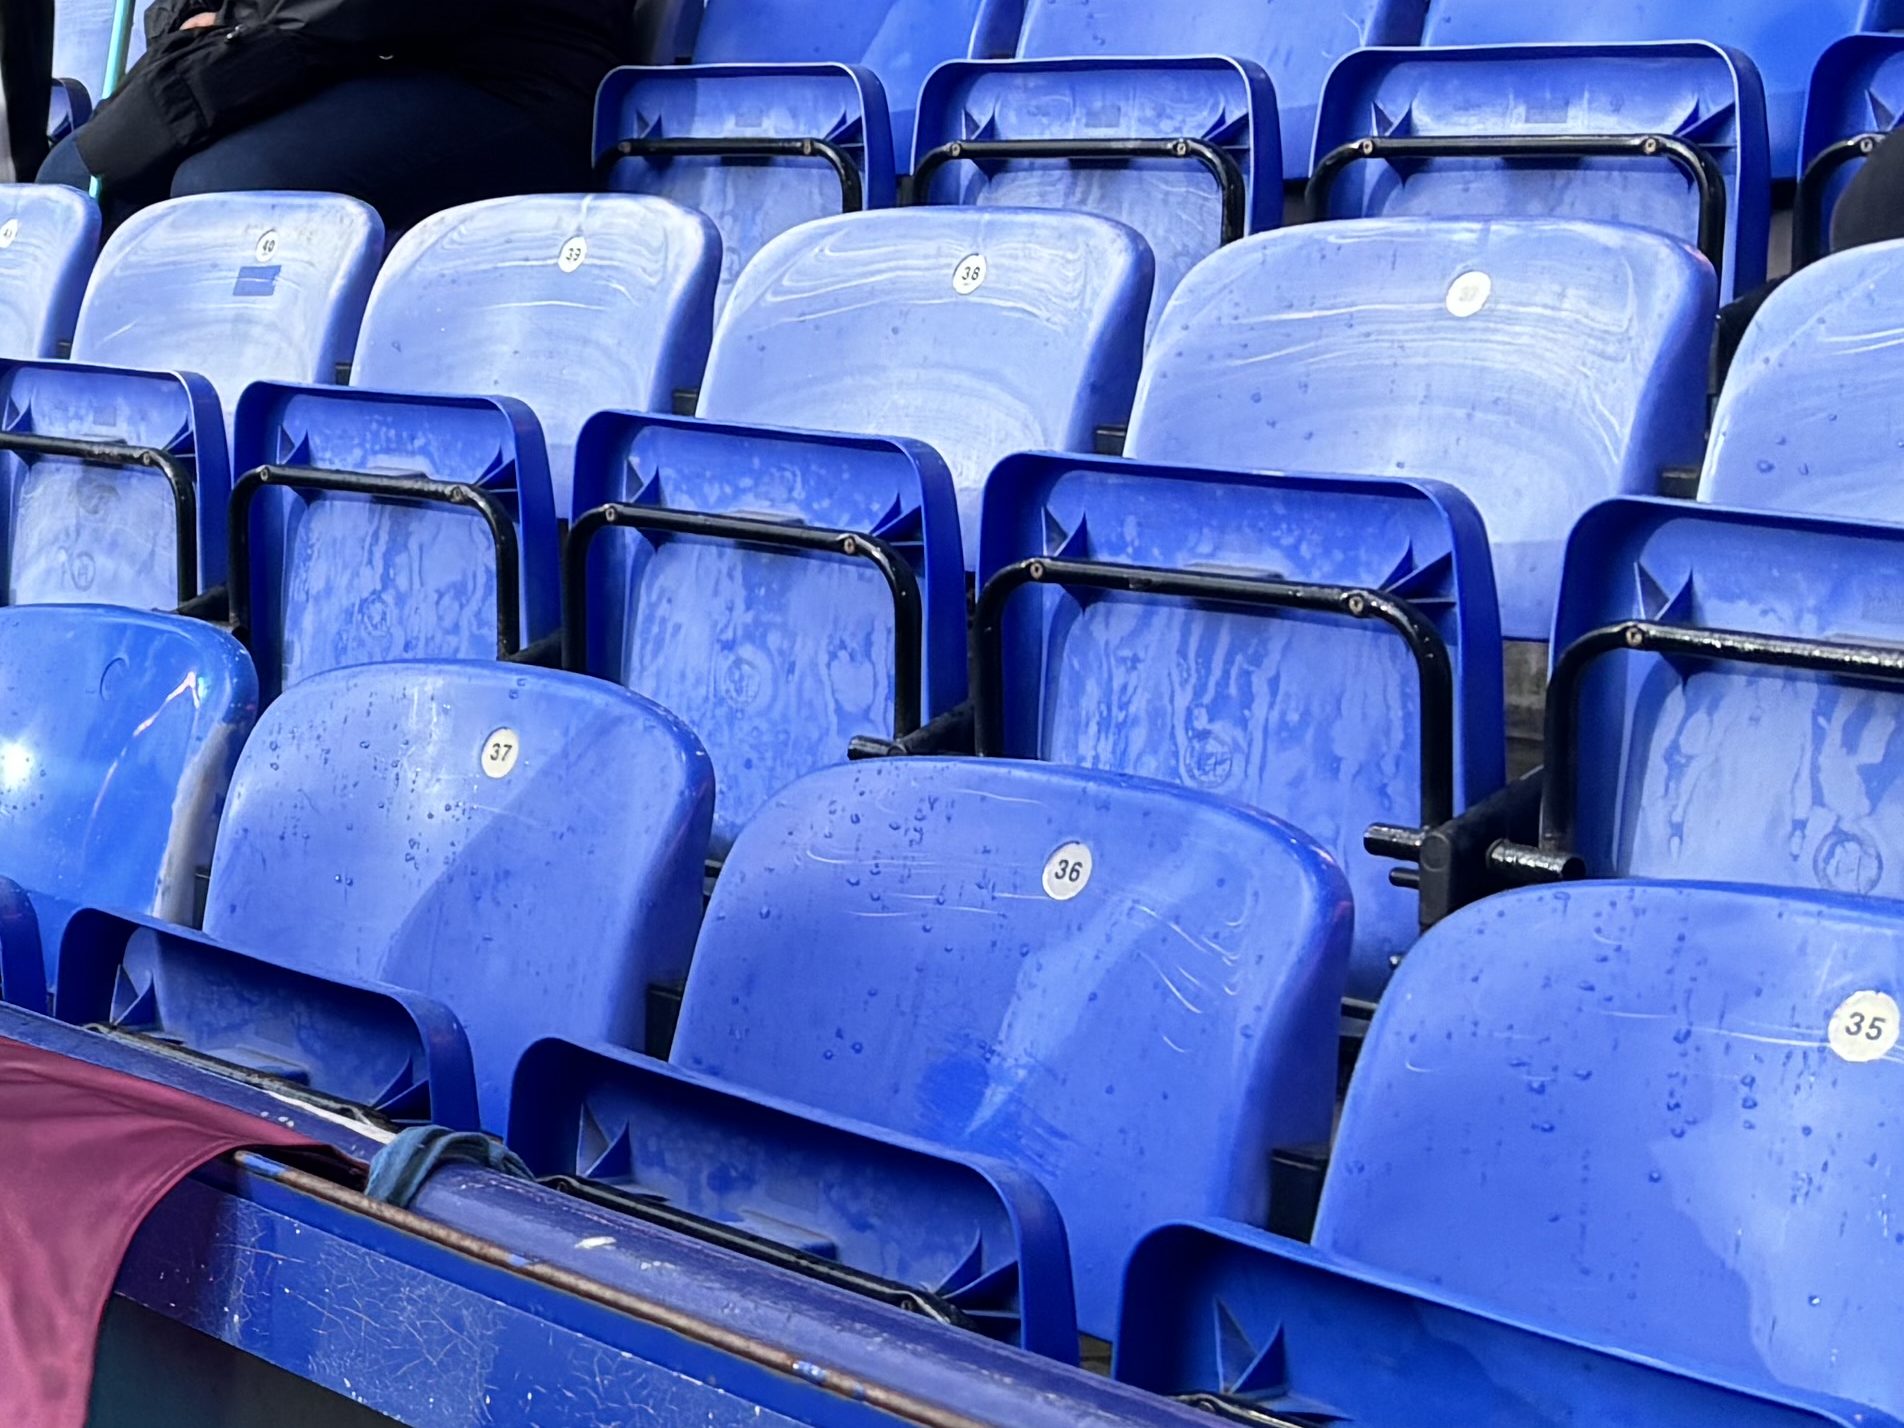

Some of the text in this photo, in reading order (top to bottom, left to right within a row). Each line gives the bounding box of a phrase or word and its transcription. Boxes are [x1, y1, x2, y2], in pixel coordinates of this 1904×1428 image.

[961, 265, 980, 281] 38
[489, 741, 513, 762] 37
[1053, 858, 1085, 883] 36
[1844, 1010, 1888, 1042] 35
